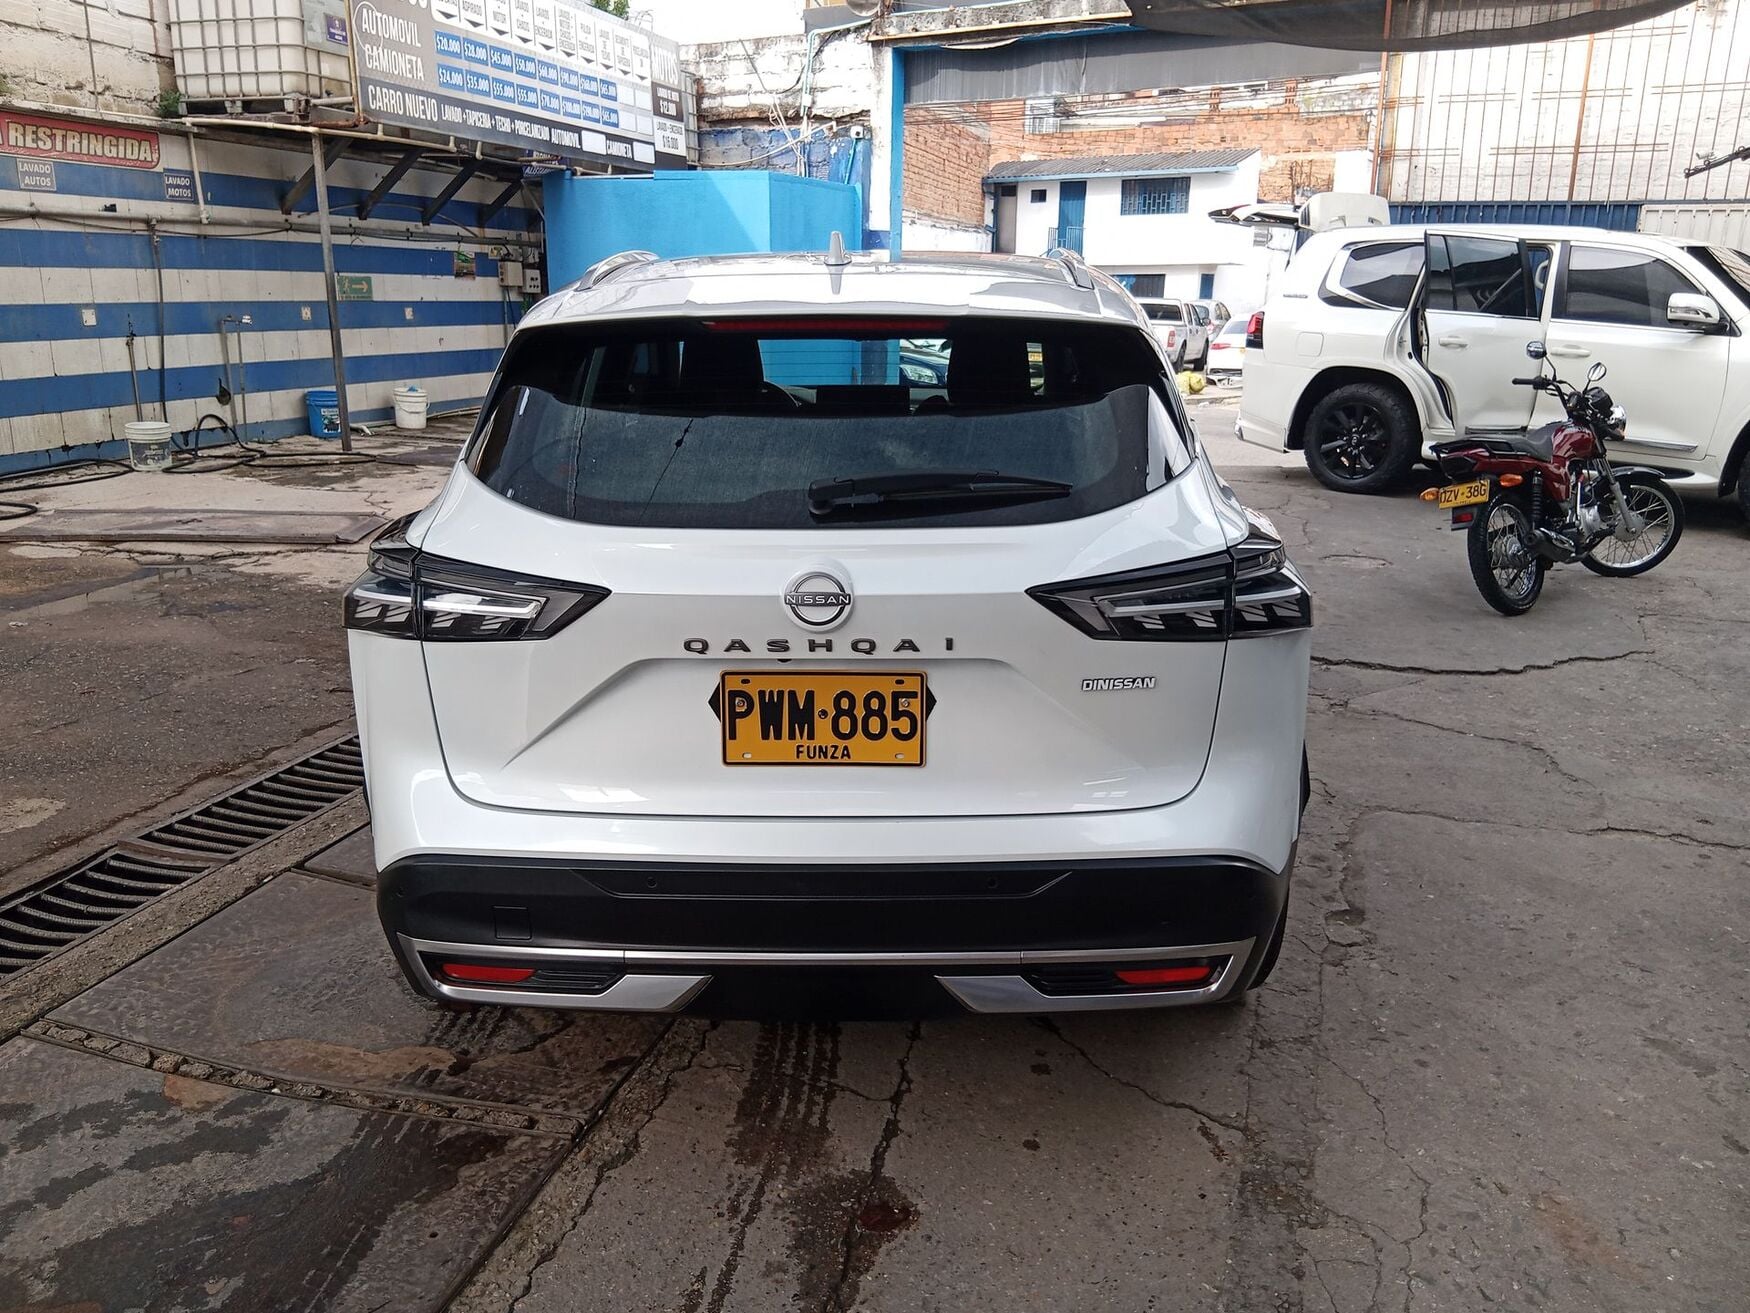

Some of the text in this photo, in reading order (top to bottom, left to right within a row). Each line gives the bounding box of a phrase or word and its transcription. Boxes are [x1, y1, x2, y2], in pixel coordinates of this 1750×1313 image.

[362, 8, 421, 47] AUTOMOVIL
[436, 34, 461, 54] $20.000
[365, 44, 424, 81] CAMIONETA
[439, 67, 463, 87] $24.000
[466, 74, 490, 93] $35.000
[368, 85, 403, 115] CARRO
[405, 92, 438, 122] NUEVO
[441, 104, 462, 123] LAVADO
[7, 121, 153, 162] RESTRINGIDA
[19, 161, 50, 173] LAVADO
[24, 176, 52, 187] AUTOS
[165, 176, 190, 186] LAVADO
[168, 187, 192, 197] MOTOS
[786, 595, 850, 605] NISSAN
[683, 638, 954, 655] QASHQAI
[1082, 677, 1156, 691] DINISSAN
[796, 744, 851, 760] FUNZA
